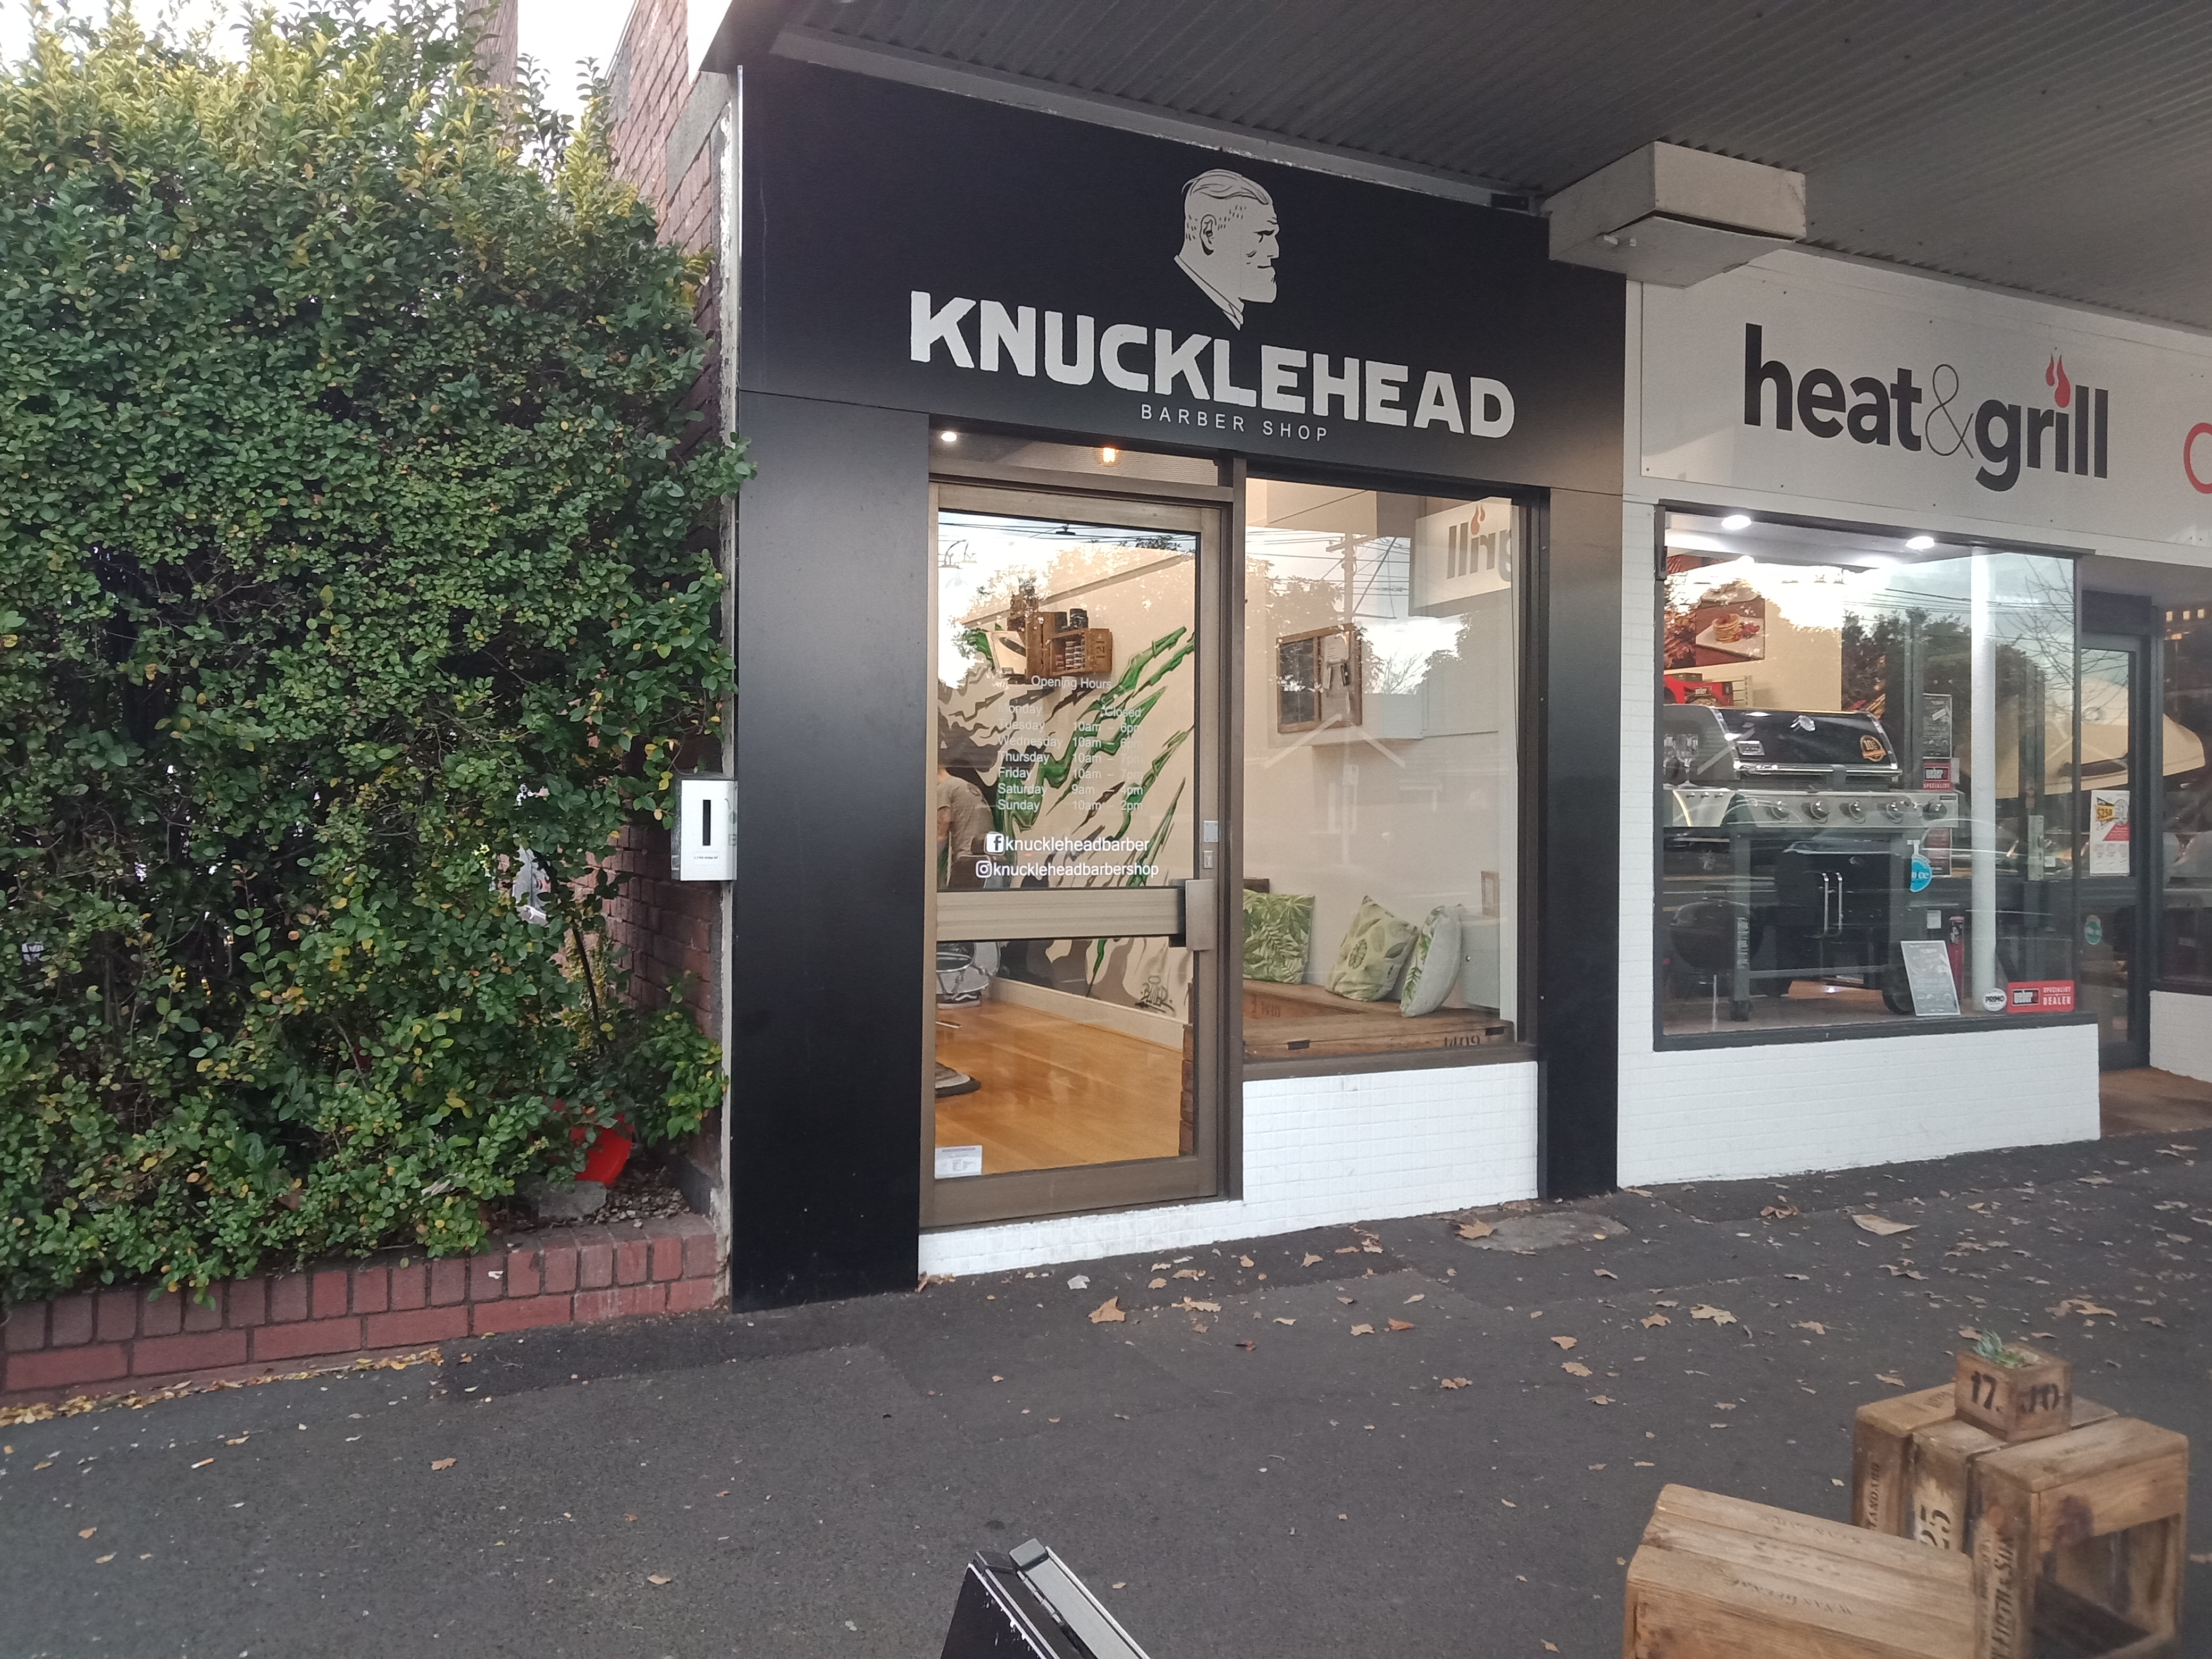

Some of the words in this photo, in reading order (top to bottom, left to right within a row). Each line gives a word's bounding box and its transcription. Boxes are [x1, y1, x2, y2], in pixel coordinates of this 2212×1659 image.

[910, 290, 1515, 439] KNUCKLEHEAD
[1141, 404, 1245, 432] BARBER
[1262, 420, 1328, 442] SHOP
[1031, 675, 1077, 690] Opening
[1080, 677, 1112, 689] Hours
[999, 703, 1042, 717] Monday
[1104, 707, 1142, 718] Closed
[999, 719, 1045, 732] Tuesday
[1073, 722, 1101, 732] 10am
[999, 735, 1062, 749] Wednesday
[1073, 738, 1101, 748] 10am
[1121, 738, 1143, 750] 6pm
[998, 750, 1050, 765] Thursday
[1073, 753, 1101, 763] 10am
[998, 767, 1031, 780] Friday
[1073, 769, 1101, 779] 10am
[998, 783, 1046, 797] Saturday
[1071, 785, 1094, 795] 9am
[1121, 785, 1143, 797] 4pm
[998, 799, 1041, 813] Sunday
[1073, 800, 1101, 810] 10am
[1121, 801, 1143, 813] 2pm
[1006, 836, 1149, 851] knuckleheadbarber
[994, 862, 1159, 878] knuckleheadbarbershop
[2043, 996, 2071, 1005] DEALER
[1865, 1463, 1880, 1530] TANDARD
